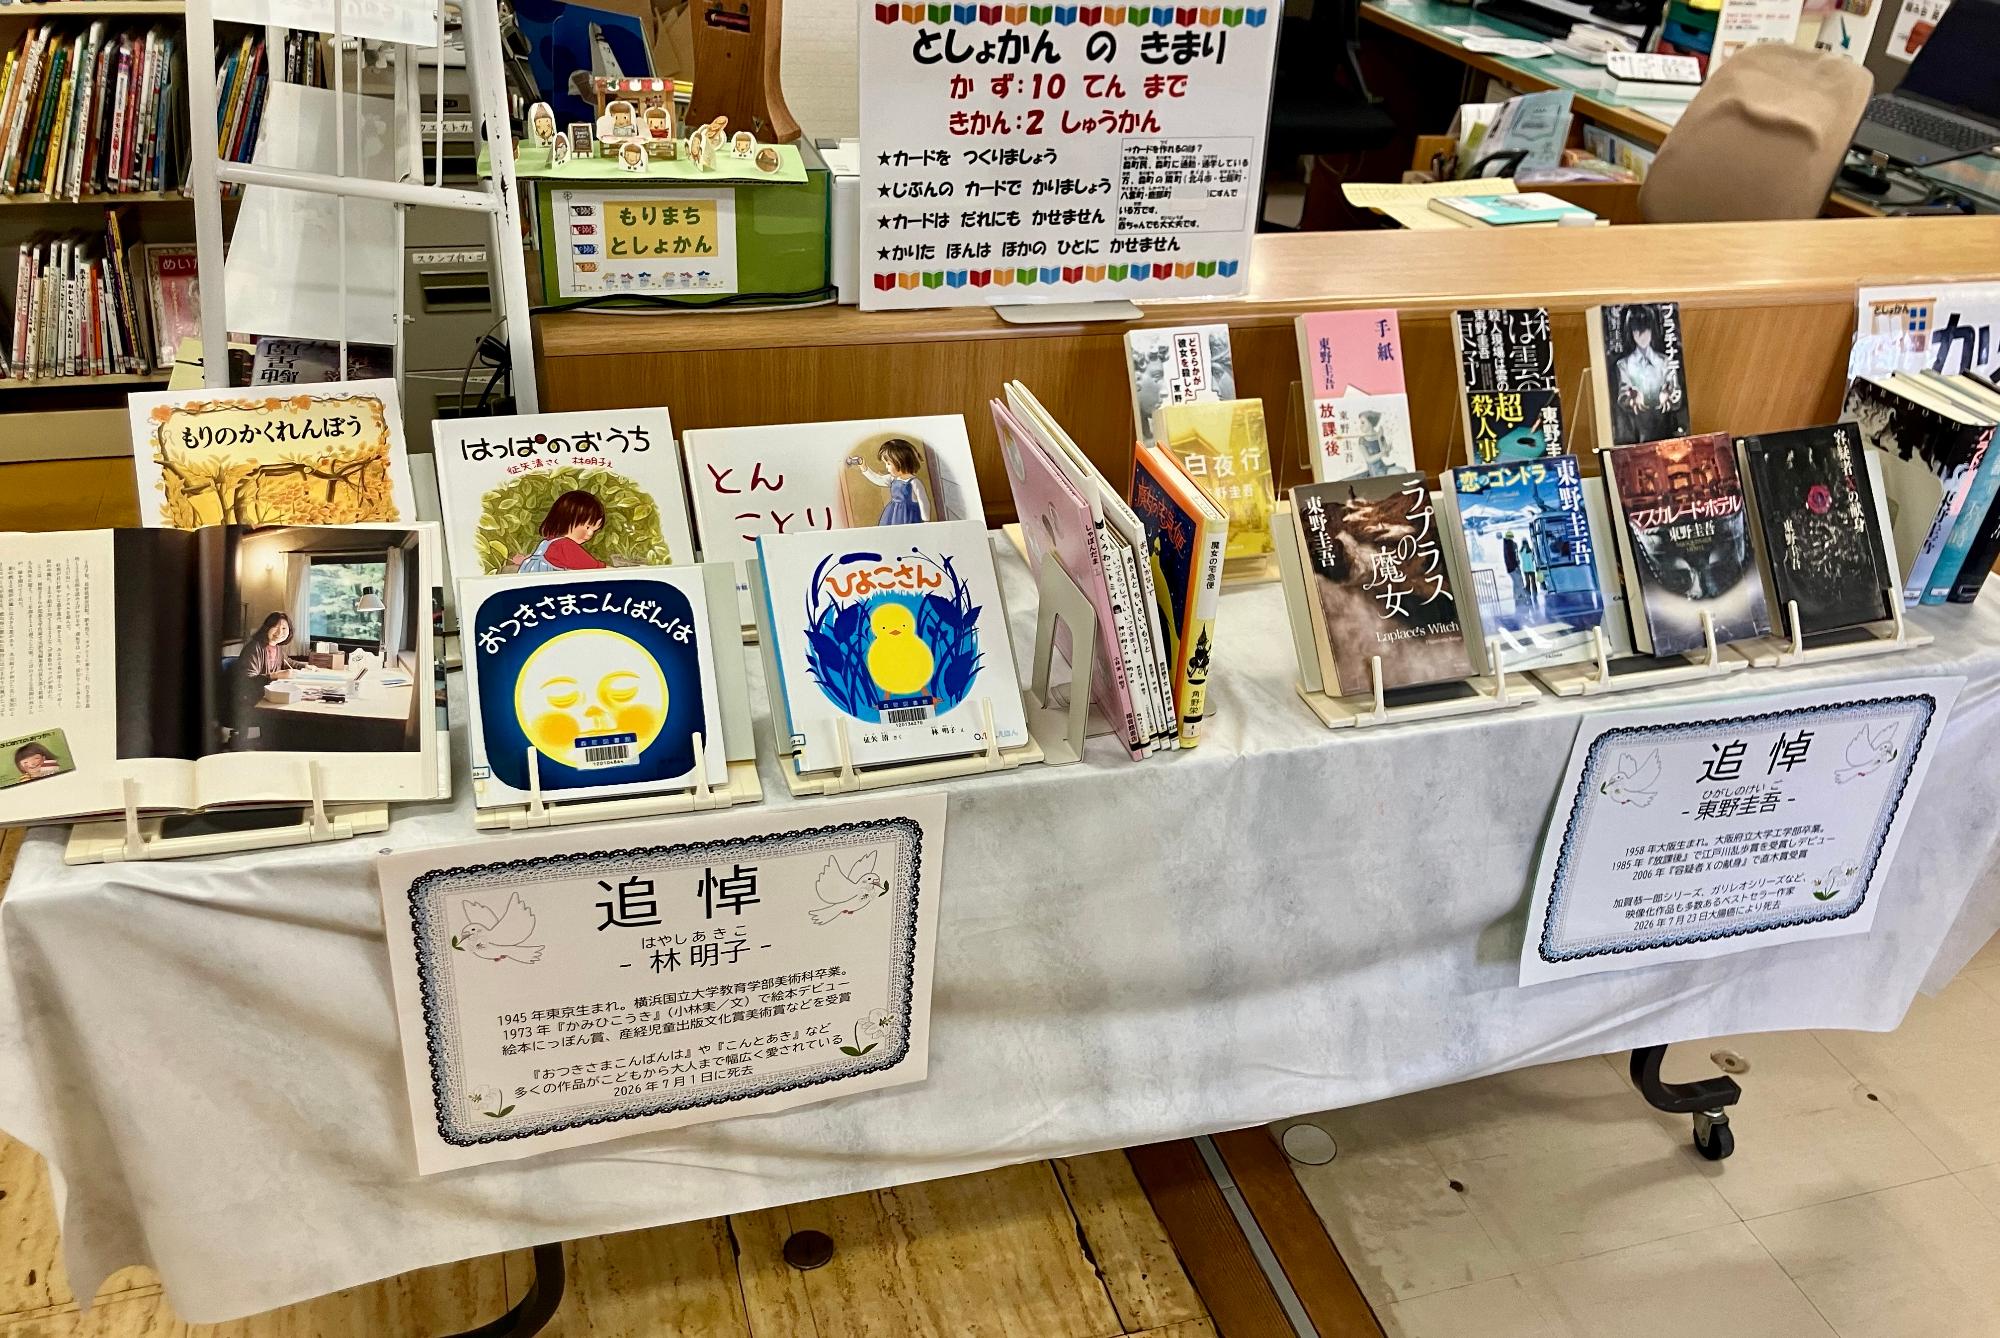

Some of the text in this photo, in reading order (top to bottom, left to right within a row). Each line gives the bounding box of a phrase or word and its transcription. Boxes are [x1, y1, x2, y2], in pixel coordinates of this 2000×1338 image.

[913, 29, 1228, 65] としょかん の きまり
[1083, 73, 1127, 99] てん
[1143, 73, 1189, 98] まで
[1061, 110, 1161, 134] しゅうかん
[963, 148, 1059, 166] つくりましょう
[965, 179, 1023, 197] カードで
[1032, 178, 1113, 196] かりましょう
[620, 206, 701, 226] もりまち
[960, 209, 1021, 228] だれにも
[1032, 208, 1106, 226] かせません
[611, 235, 712, 255] としょかん
[946, 241, 992, 259] ほんは
[1001, 240, 1048, 257] ほかの
[1057, 238, 1100, 255] ひとに
[1109, 236, 1181, 254] かせません
[162, 258, 198, 270] めい
[1375, 319, 1395, 362] 手紙
[1189, 338, 1201, 385] どちらかが
[1319, 337, 1335, 390] 東野圭吾
[181, 414, 362, 449] もりのかくれんぼう
[461, 425, 650, 461] はっぱのおうち
[1319, 403, 1340, 456] 放課後
[1471, 394, 1499, 464] 殺人事
[707, 462, 784, 494] とん
[1185, 448, 1261, 478] 白夜行
[1459, 464, 1547, 492] 恋のゴンドラ
[1206, 484, 1253, 499] 野圭吾
[1556, 459, 1592, 566] 東野圭吾
[1629, 495, 1743, 530] マスカレード・ホテル
[1085, 524, 1100, 565] しゃぼんだま
[1305, 496, 1336, 568] 東野圭吾
[1401, 479, 1454, 606] ラプラス
[826, 564, 942, 598] ひよこさん
[1206, 541, 1220, 590] 魔女の宅急便
[1362, 535, 1418, 620] の魔女
[478, 592, 697, 655] おつきさまこんばんは
[1375, 625, 1426, 643] Laplace's
[1427, 621, 1460, 636] Witch
